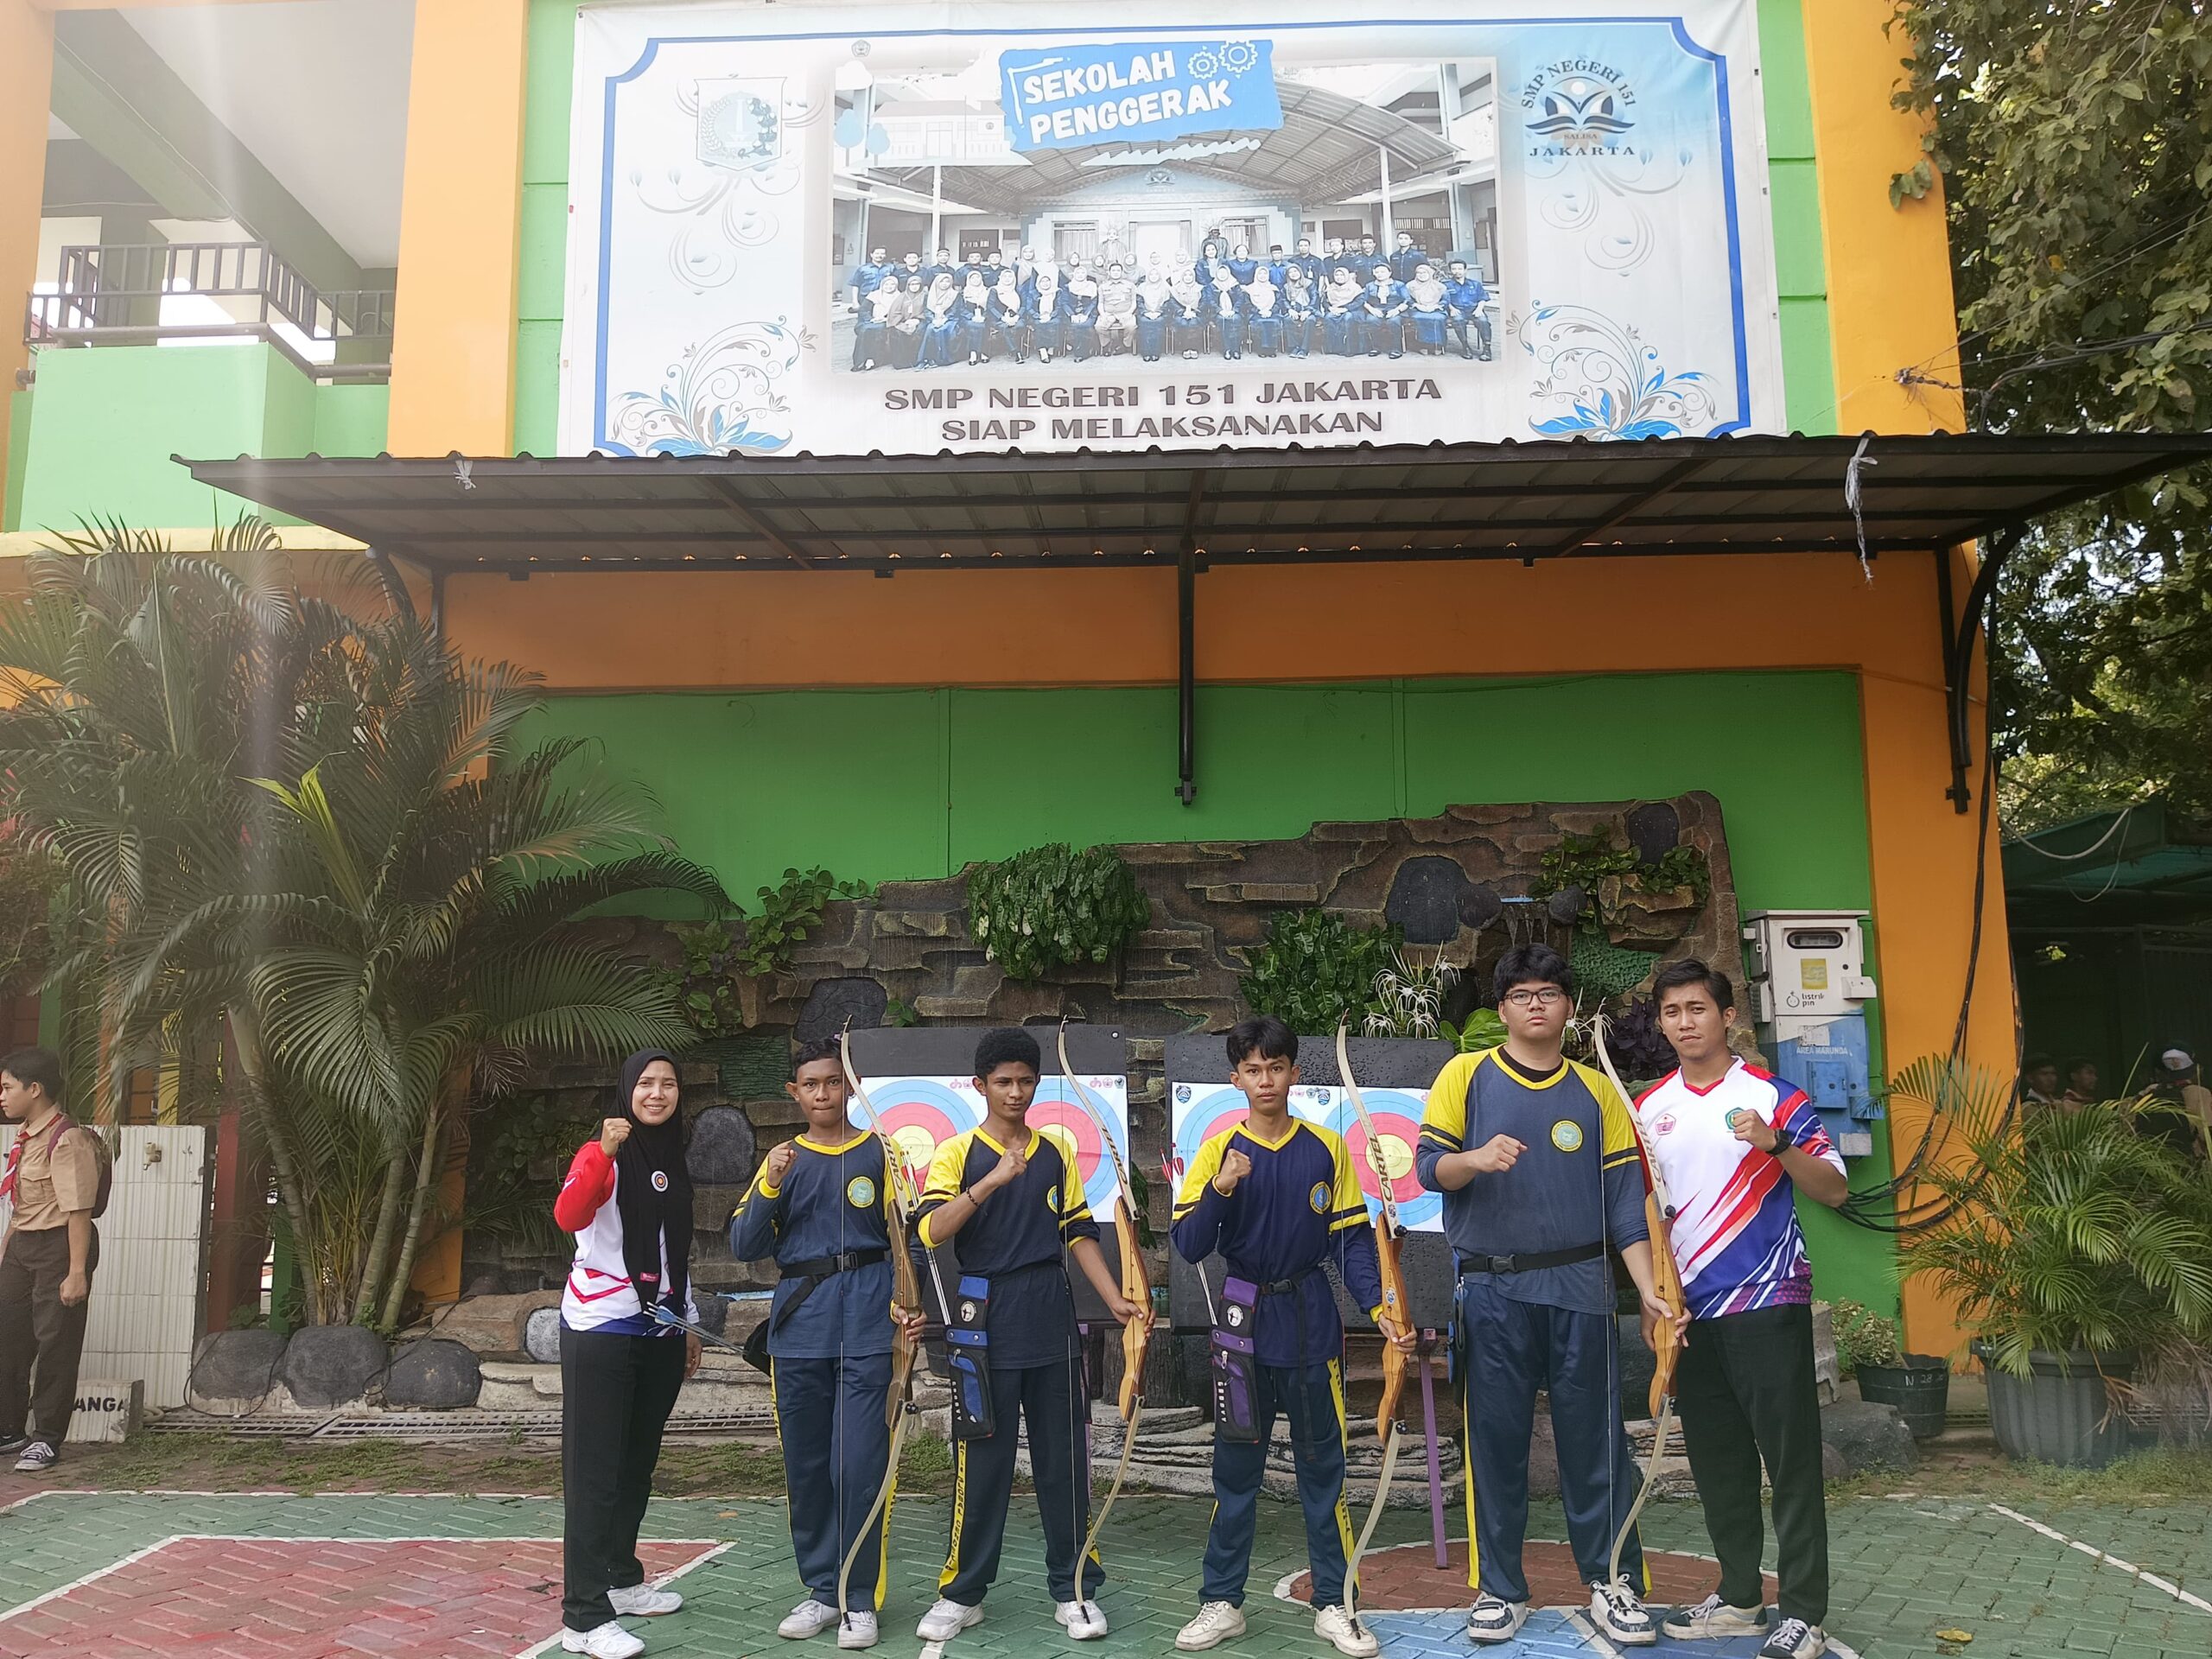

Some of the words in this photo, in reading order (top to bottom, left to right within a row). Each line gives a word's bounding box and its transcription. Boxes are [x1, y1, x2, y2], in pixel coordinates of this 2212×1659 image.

[1022, 50, 1176, 105] SEKOLAH
[1521, 74, 1546, 109] SMP
[1546, 59, 1621, 84] NEGERI
[1618, 84, 1637, 107] 151
[1029, 79, 1232, 144] PENGGERAK
[1529, 146, 1635, 156] JAKARTA
[885, 389, 974, 410] SMP
[988, 386, 1139, 409] NEGERI
[1159, 384, 1234, 405] 151
[1255, 378, 1442, 404] JAKARTA
[942, 419, 1036, 442] SIAP
[1052, 411, 1382, 440] MELAKSANAKAN
[1815, 1046, 1848, 1055] MARUNDA
[1370, 1133, 1393, 1202] CARTEL
